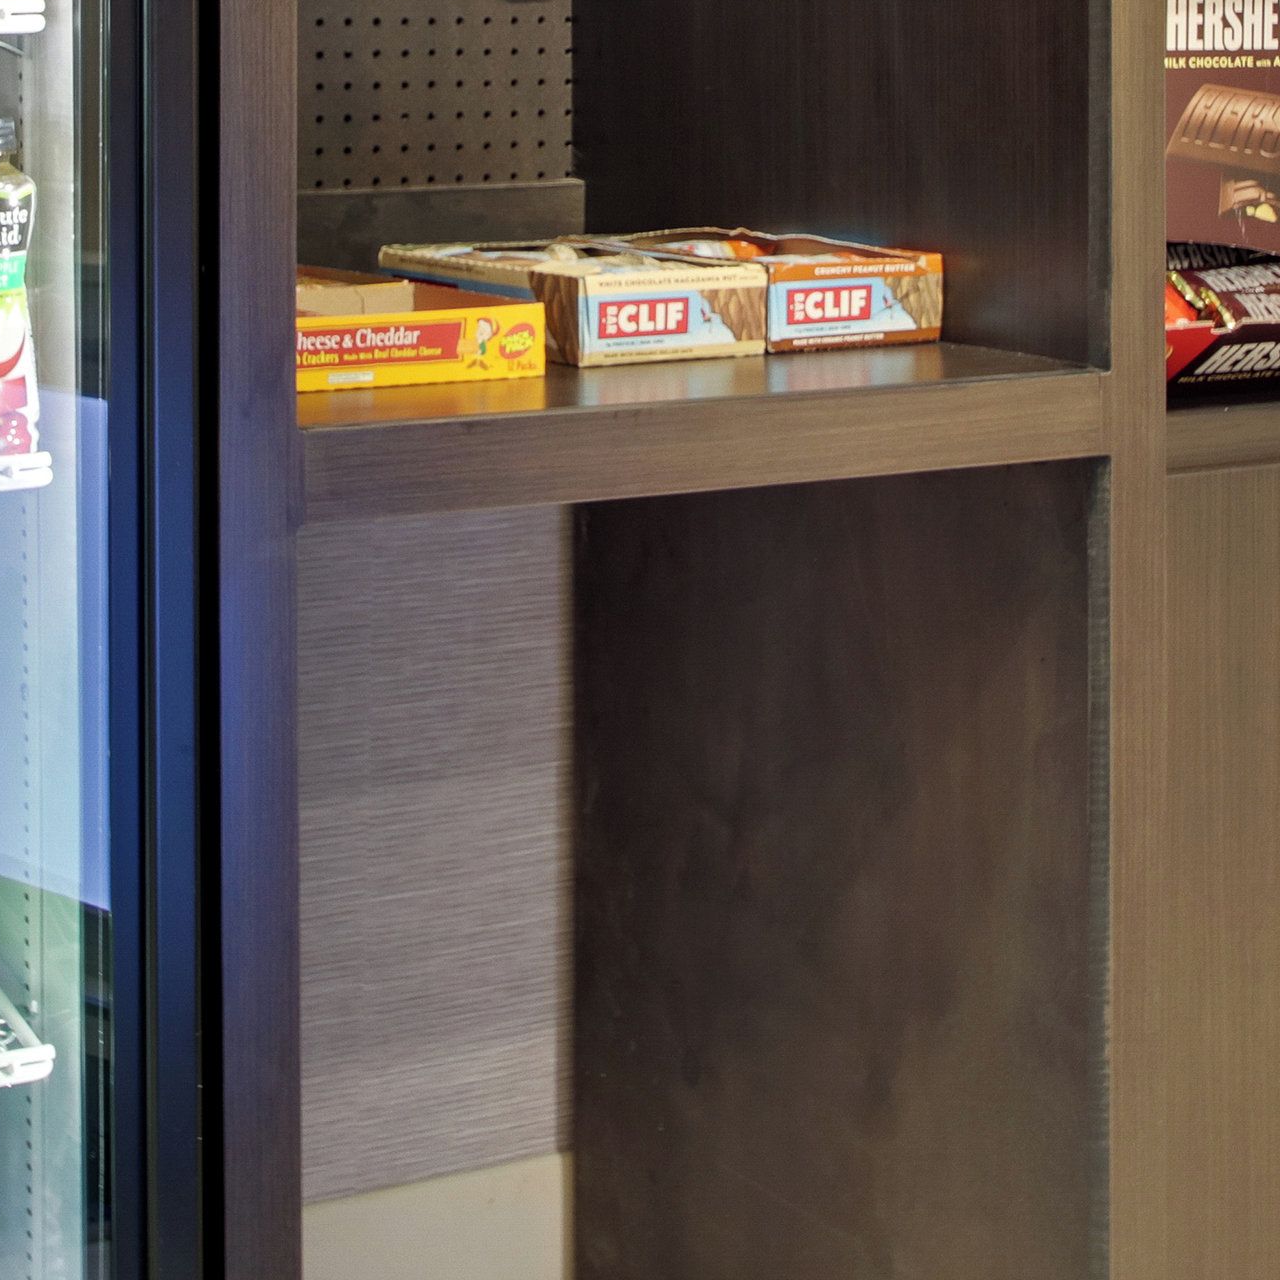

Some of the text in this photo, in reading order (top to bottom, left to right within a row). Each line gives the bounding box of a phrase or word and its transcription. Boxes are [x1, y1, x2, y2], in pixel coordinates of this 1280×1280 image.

[1188, 56, 1254, 68] CHOCOLATE
[1256, 59, 1271, 67] with
[814, 263, 916, 276] CRUNCHY PEANUT BUTTER
[624, 279, 672, 287] CHOCOLATE
[674, 275, 720, 284] MACADAMIA
[793, 289, 868, 322] BAR CLIF
[605, 301, 685, 335] BAR CLIF
[341, 334, 353, 348] &
[355, 326, 421, 349] Cheddar
[302, 351, 340, 365] Crackers
[373, 348, 390, 359] Real
[418, 346, 443, 356] Cheese
[1177, 375, 1204, 384] MILK
[1206, 370, 1271, 383] CHOCOLATE
